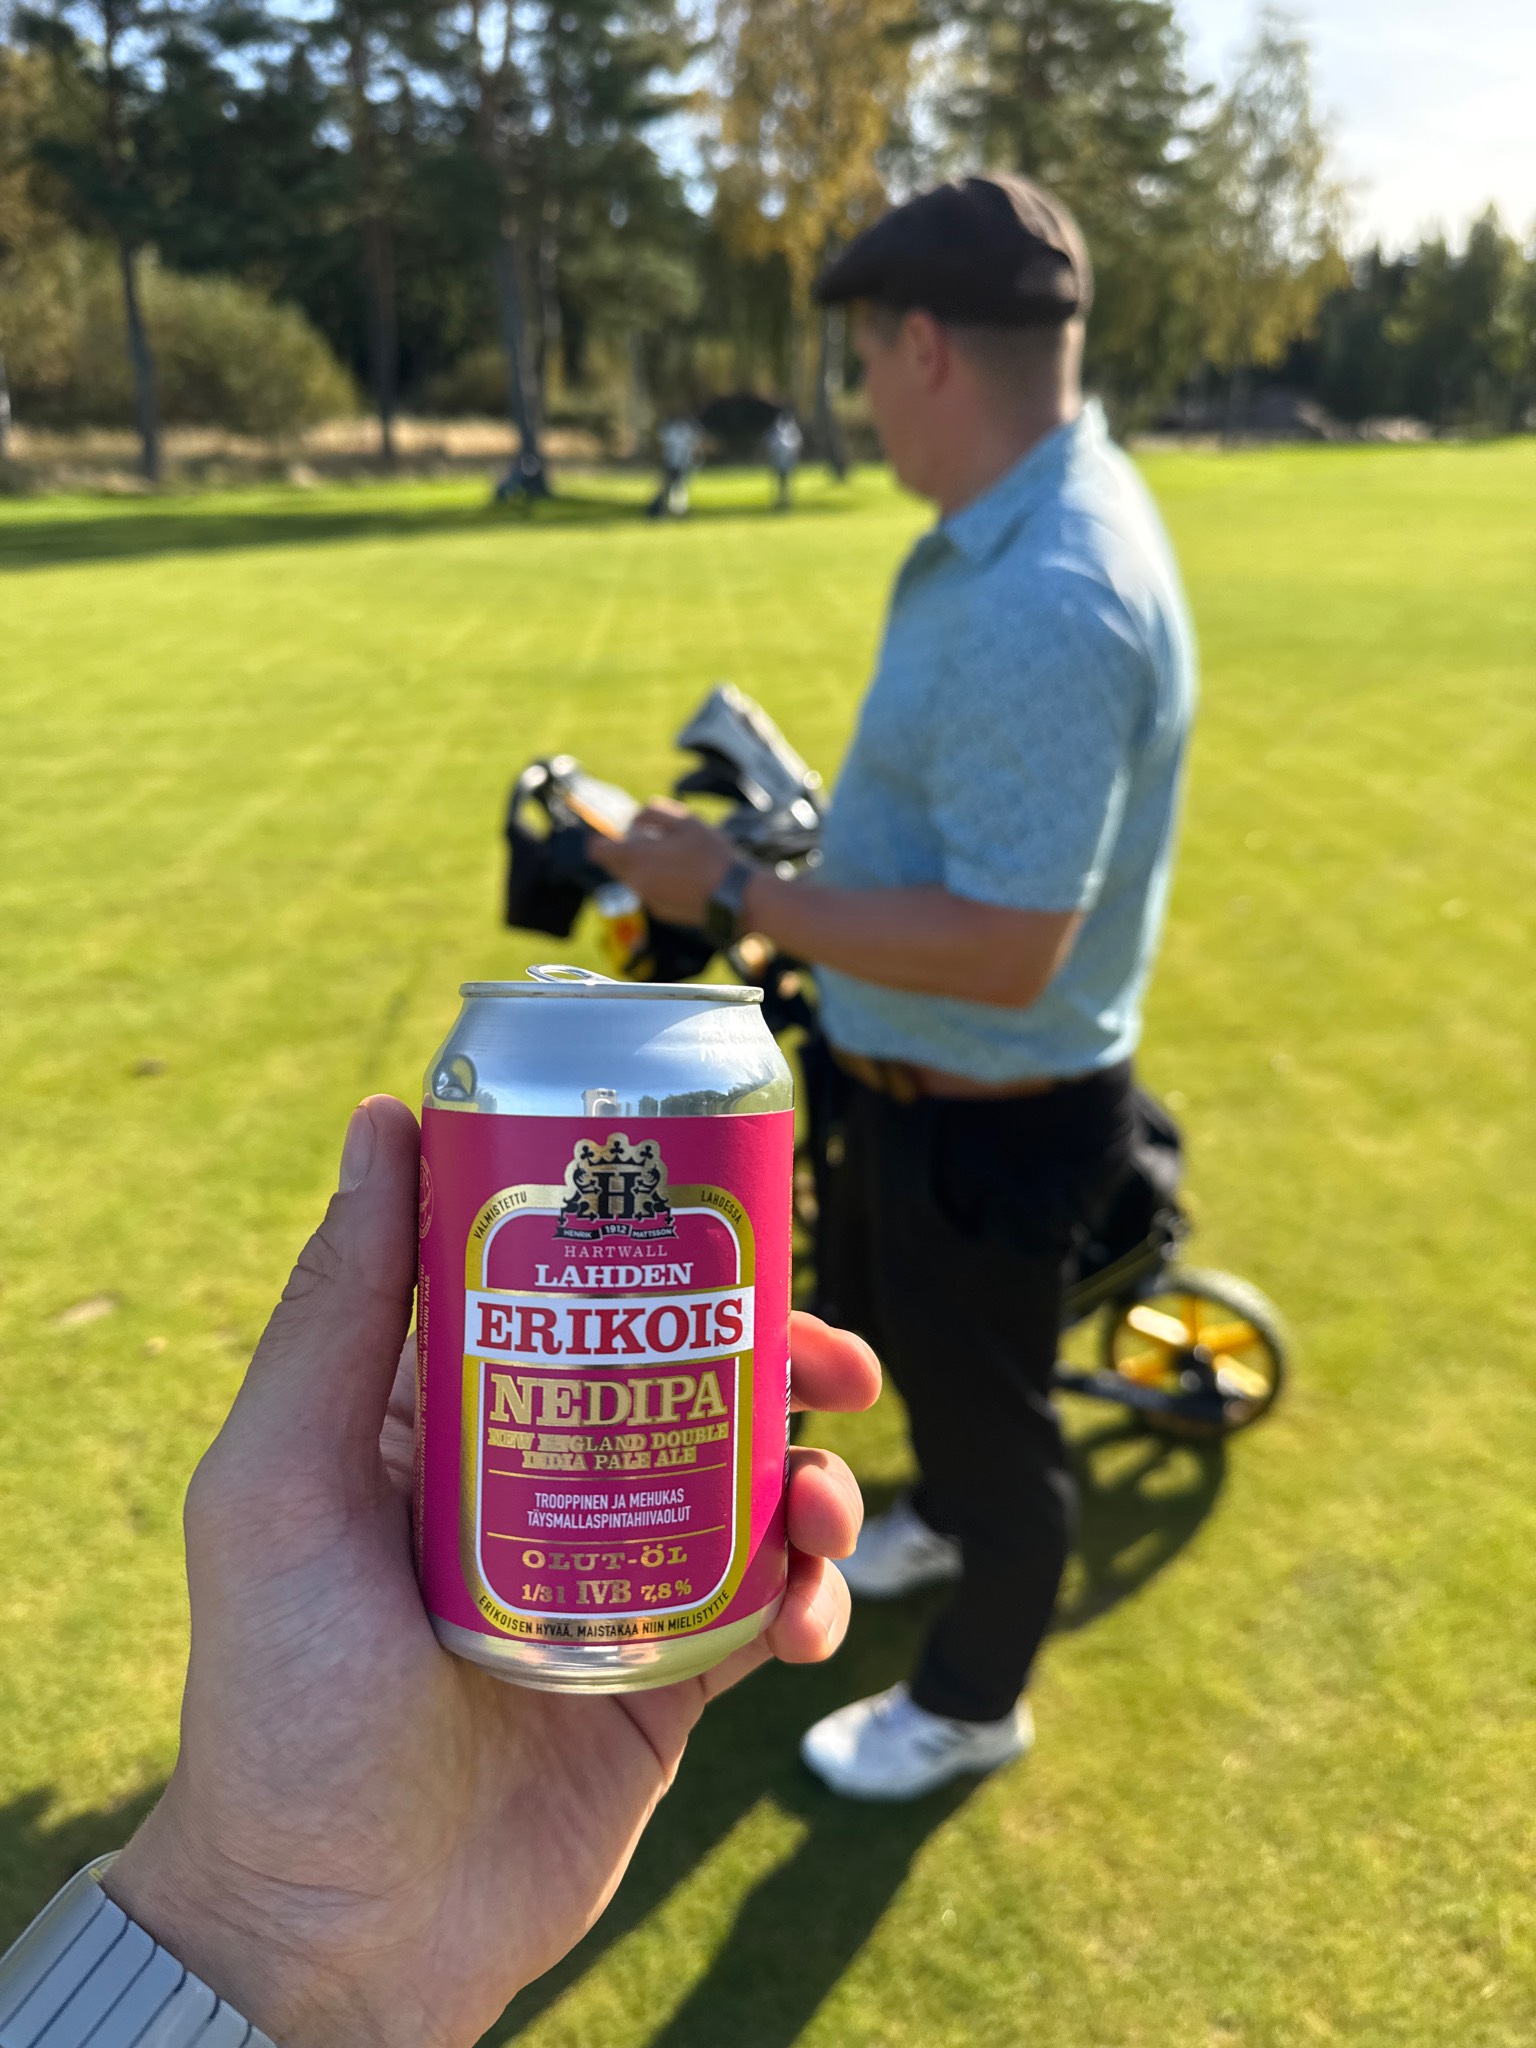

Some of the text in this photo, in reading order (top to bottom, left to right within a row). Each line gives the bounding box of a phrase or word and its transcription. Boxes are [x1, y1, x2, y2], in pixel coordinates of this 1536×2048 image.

[597, 1172, 639, 1218] H
[700, 1190, 742, 1225] LAHDESSA
[474, 1190, 529, 1240] VALMISTETTU
[563, 1224, 673, 1239] HENRIK 1912 MATTSSON
[563, 1244, 668, 1258] HARTWALL
[533, 1262, 694, 1289] LAHDEN
[476, 1297, 744, 1355] ERIKOIS
[490, 1370, 728, 1427] NEDIPA
[487, 1421, 730, 1453] NEW GLAND DOUBLE
[521, 1446, 698, 1470] IDIA PALE ALE
[534, 1487, 685, 1510] TROOPPINEN JA MEHUKAS
[526, 1505, 692, 1530] TÄYSMALLASPINTAHIIVAOLUT
[522, 1544, 688, 1570] OLUT-ÖL
[521, 1583, 553, 1602] 1/3
[575, 1579, 632, 1605] IVB
[478, 1595, 533, 1635] ERIKOISEN
[576, 1624, 639, 1638] MAISTAKAA
[641, 1620, 665, 1634] NIIN
[667, 1589, 730, 1631] MIELISTYTTE
